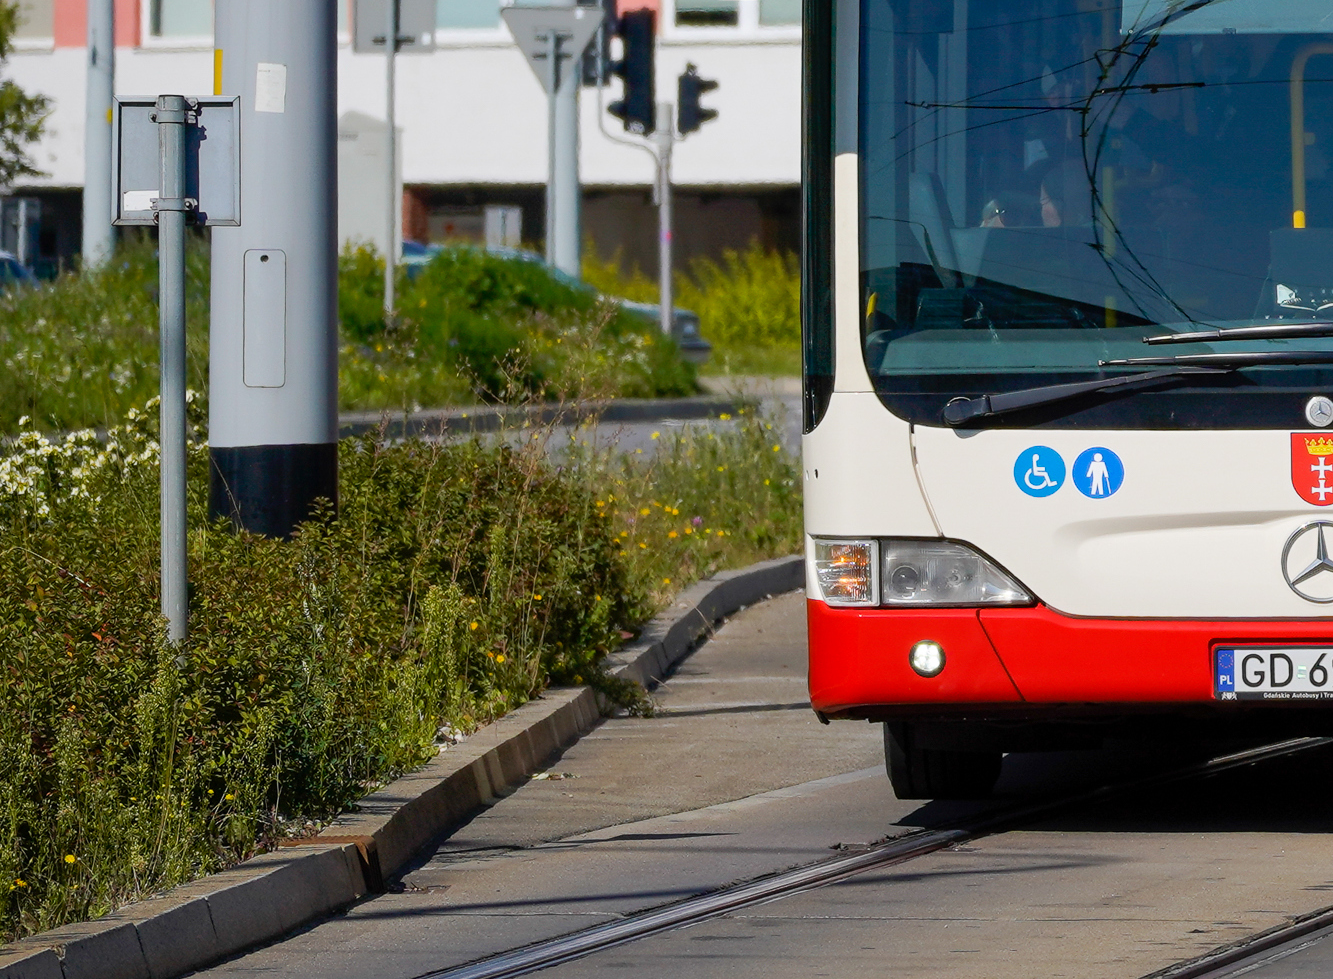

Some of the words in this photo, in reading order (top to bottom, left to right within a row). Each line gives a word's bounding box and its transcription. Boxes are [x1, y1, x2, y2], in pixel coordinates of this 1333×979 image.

[1241, 653, 1294, 688] GD
[1219, 674, 1233, 685] PL
[1292, 692, 1319, 700] Autobusy
